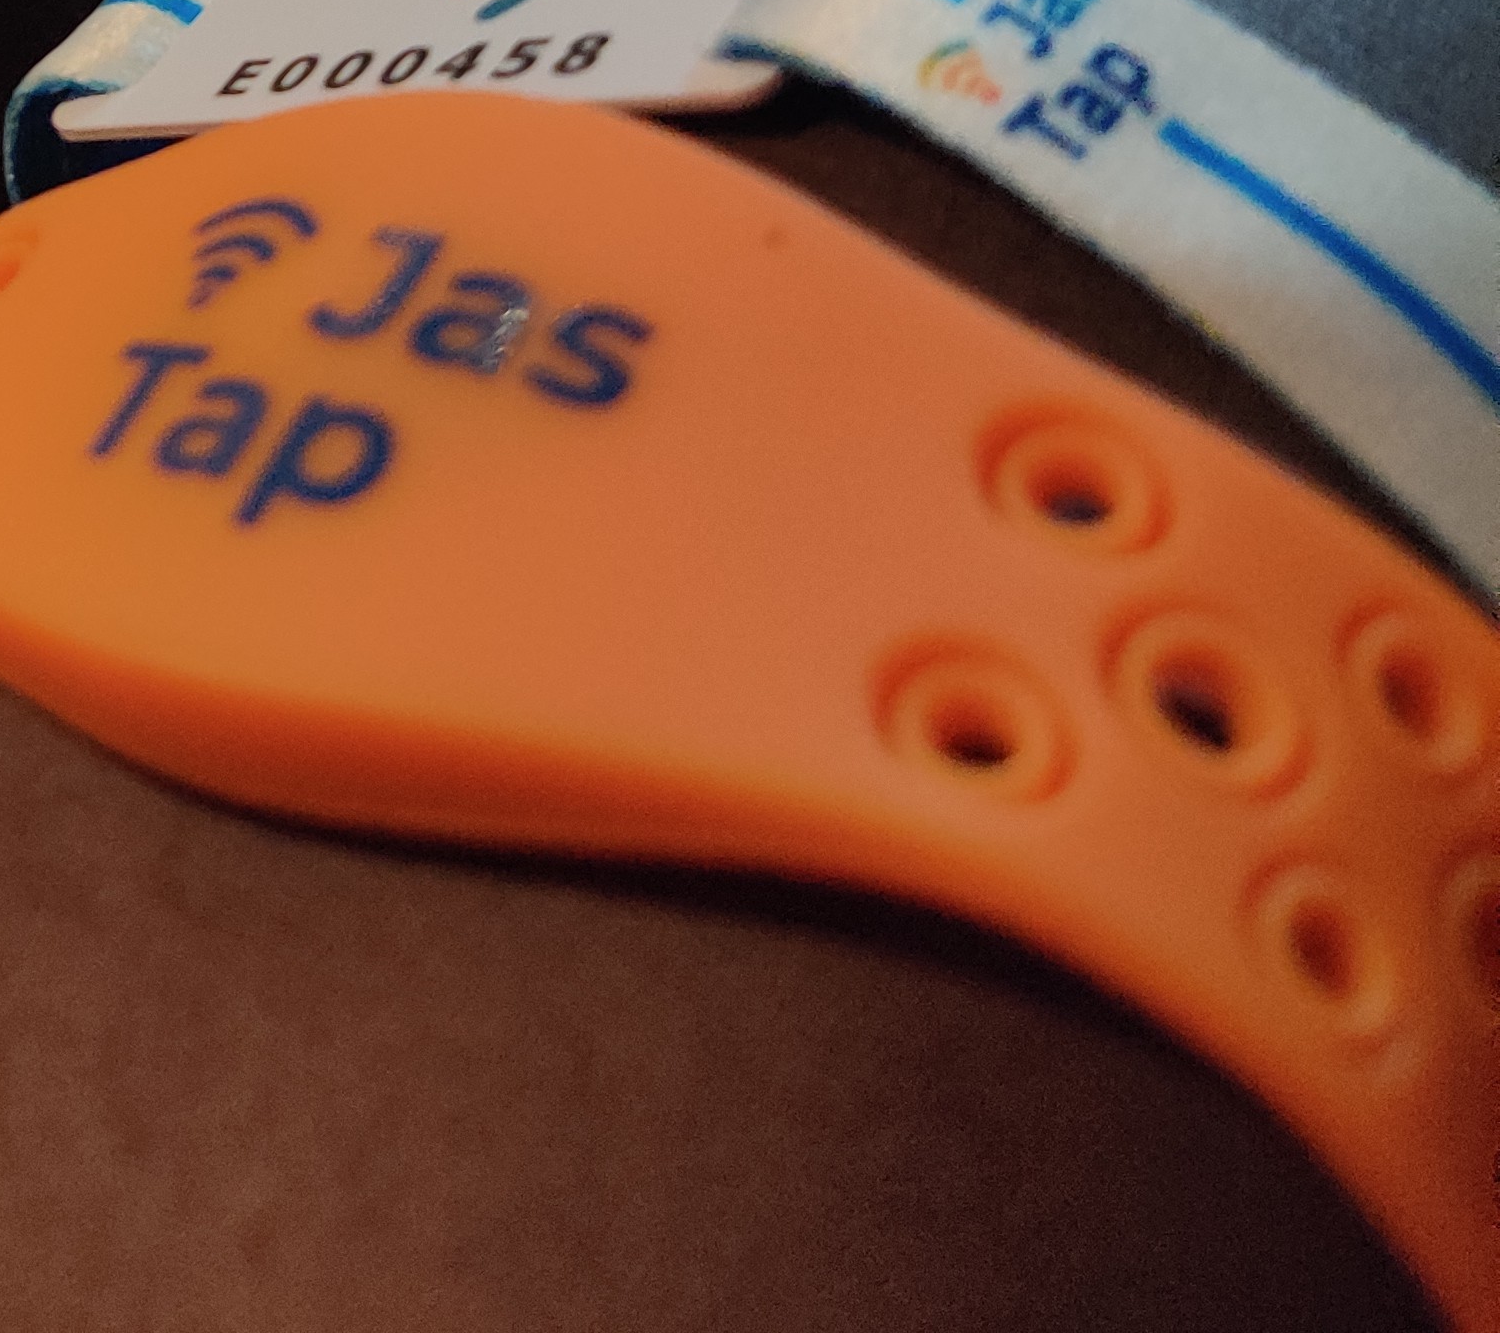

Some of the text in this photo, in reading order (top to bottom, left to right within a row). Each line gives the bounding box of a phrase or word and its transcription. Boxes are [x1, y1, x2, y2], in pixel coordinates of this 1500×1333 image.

[217, 34, 611, 97] E000458
[1002, 43, 1156, 159] Tap
[309, 226, 654, 407] Jas
[91, 342, 396, 526] Tap
